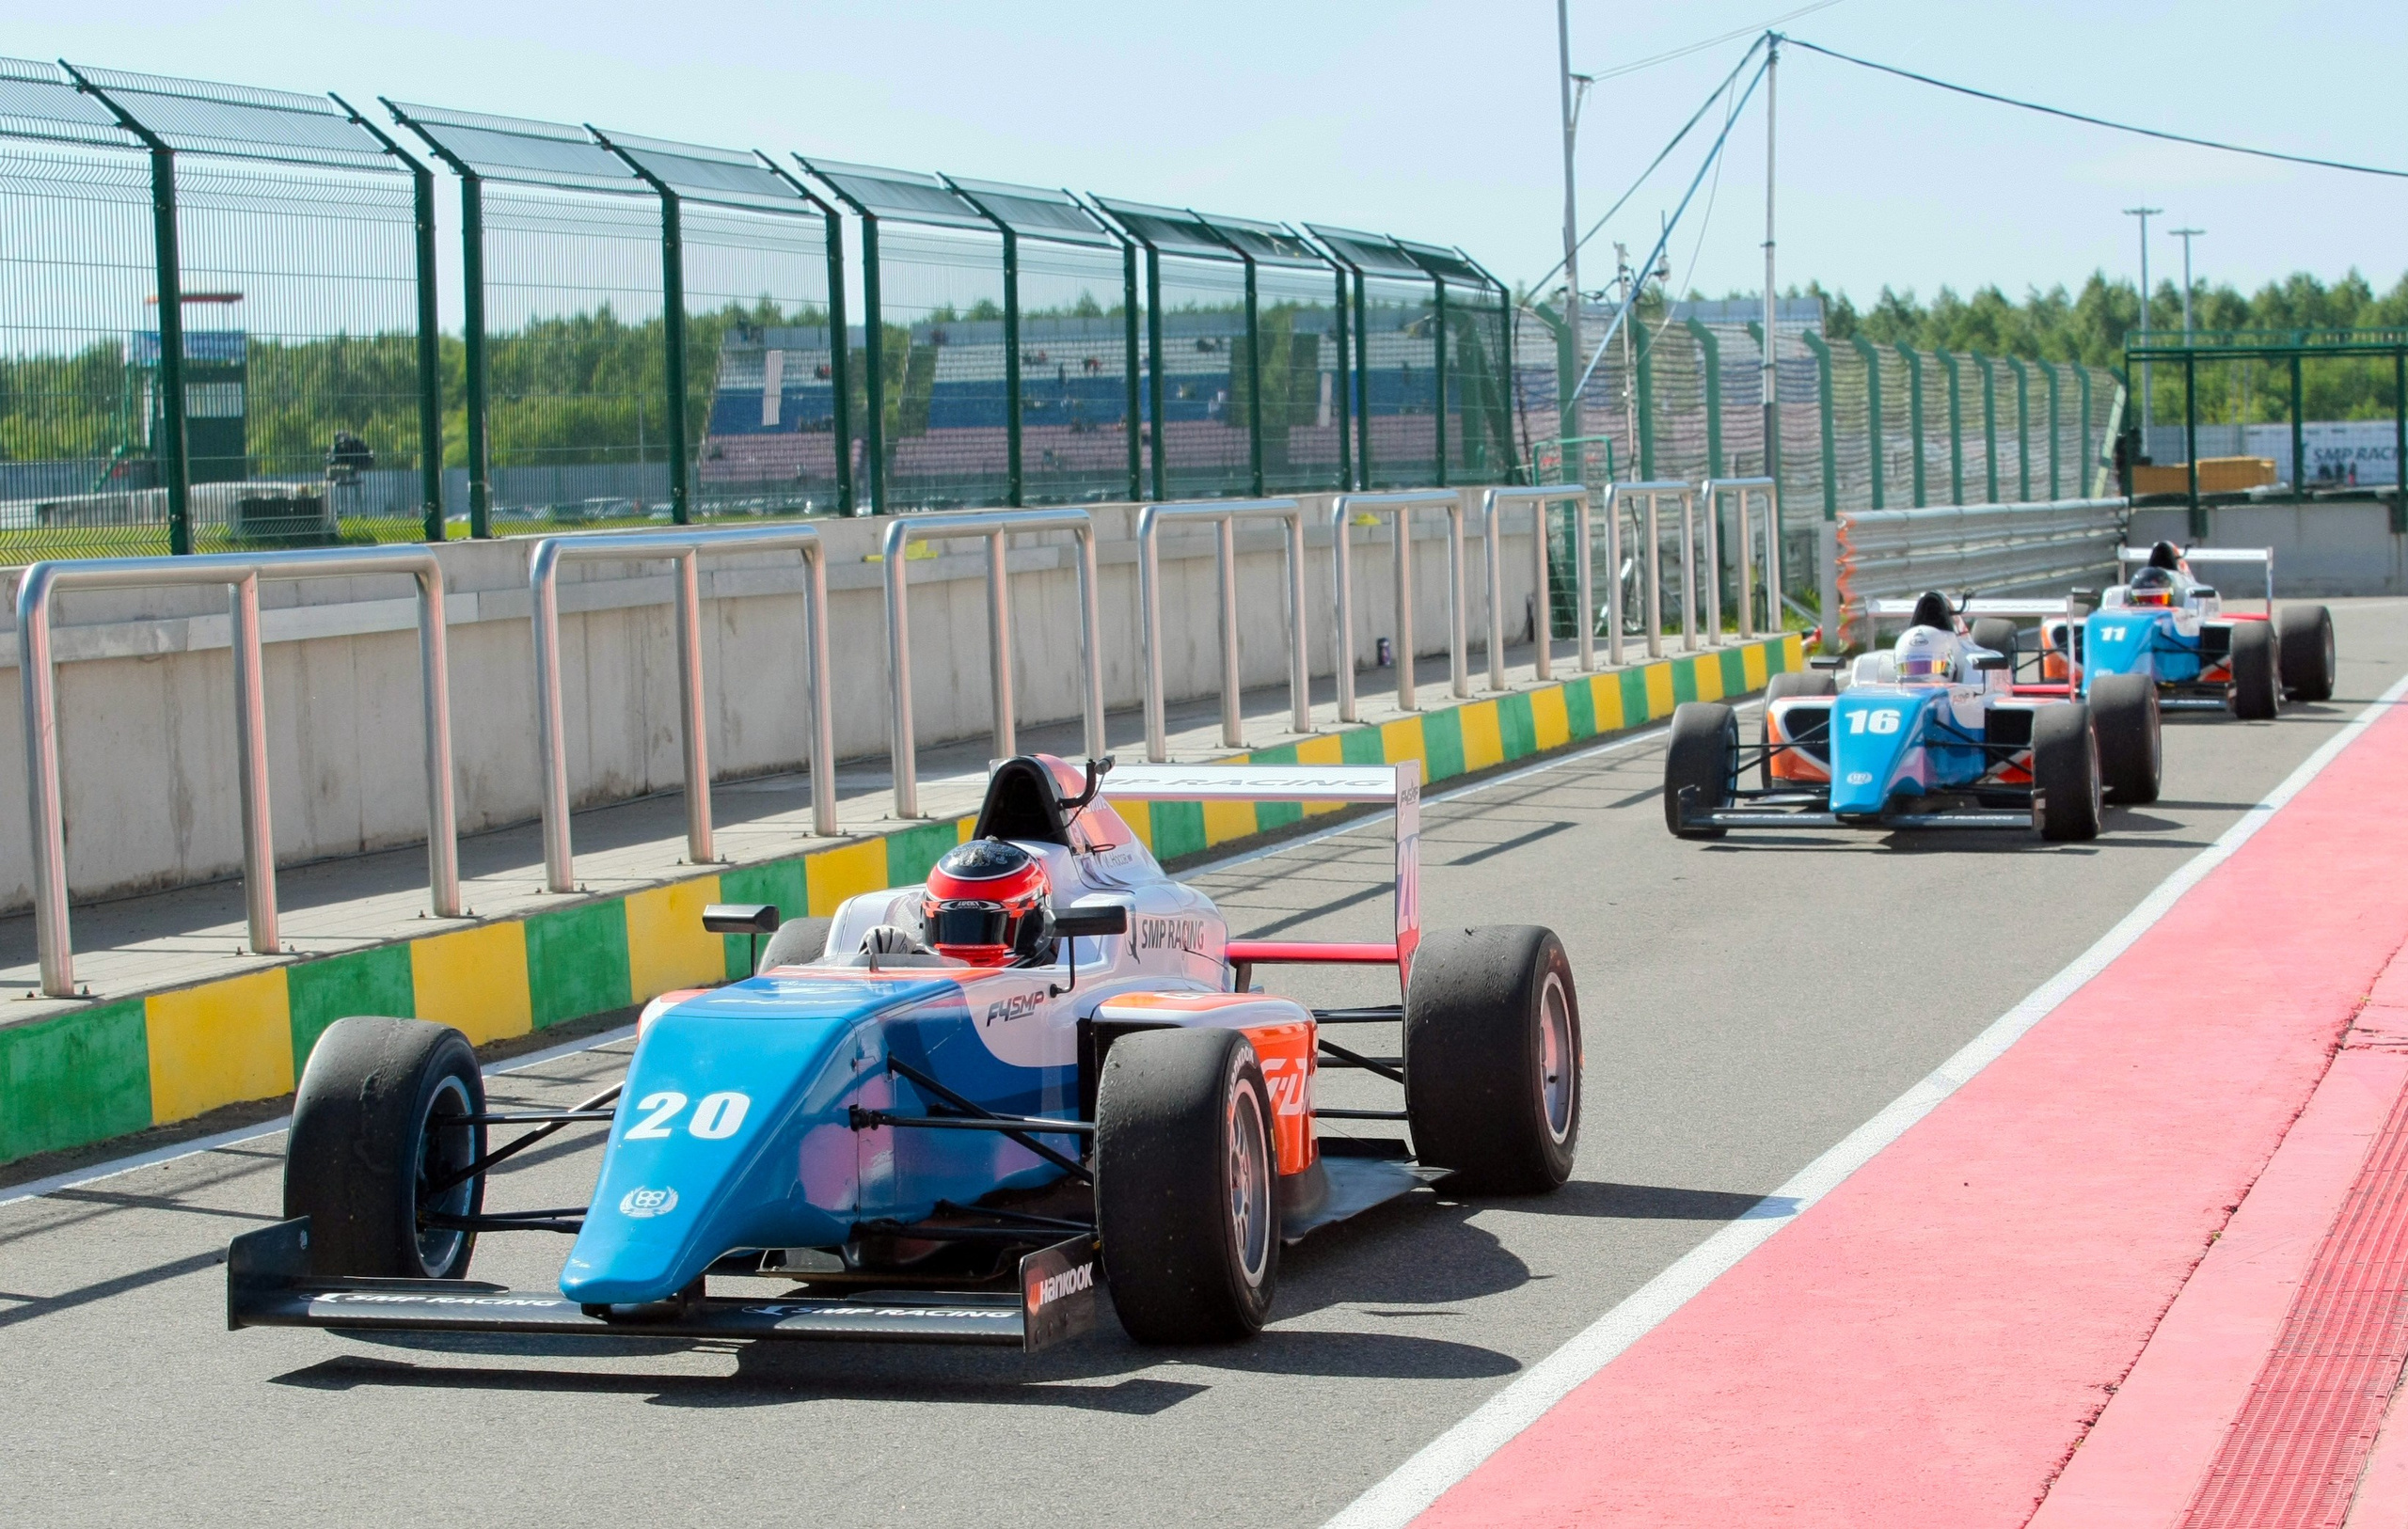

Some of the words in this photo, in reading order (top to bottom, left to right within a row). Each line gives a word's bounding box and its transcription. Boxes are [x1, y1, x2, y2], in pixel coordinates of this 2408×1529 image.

[2314, 448, 2353, 463] SMP
[2099, 626, 2126, 640] 11
[1845, 709, 1901, 734] 16
[1398, 836, 1419, 937] 20
[1141, 919, 1166, 949] SMP
[1167, 920, 1204, 951] RACING
[986, 990, 1045, 1028] F4SMP
[623, 1092, 751, 1141] 20
[345, 1294, 426, 1302] SMP
[425, 1297, 562, 1306] RACING
[791, 1306, 873, 1315] SMP
[875, 1309, 1017, 1318] RACING
